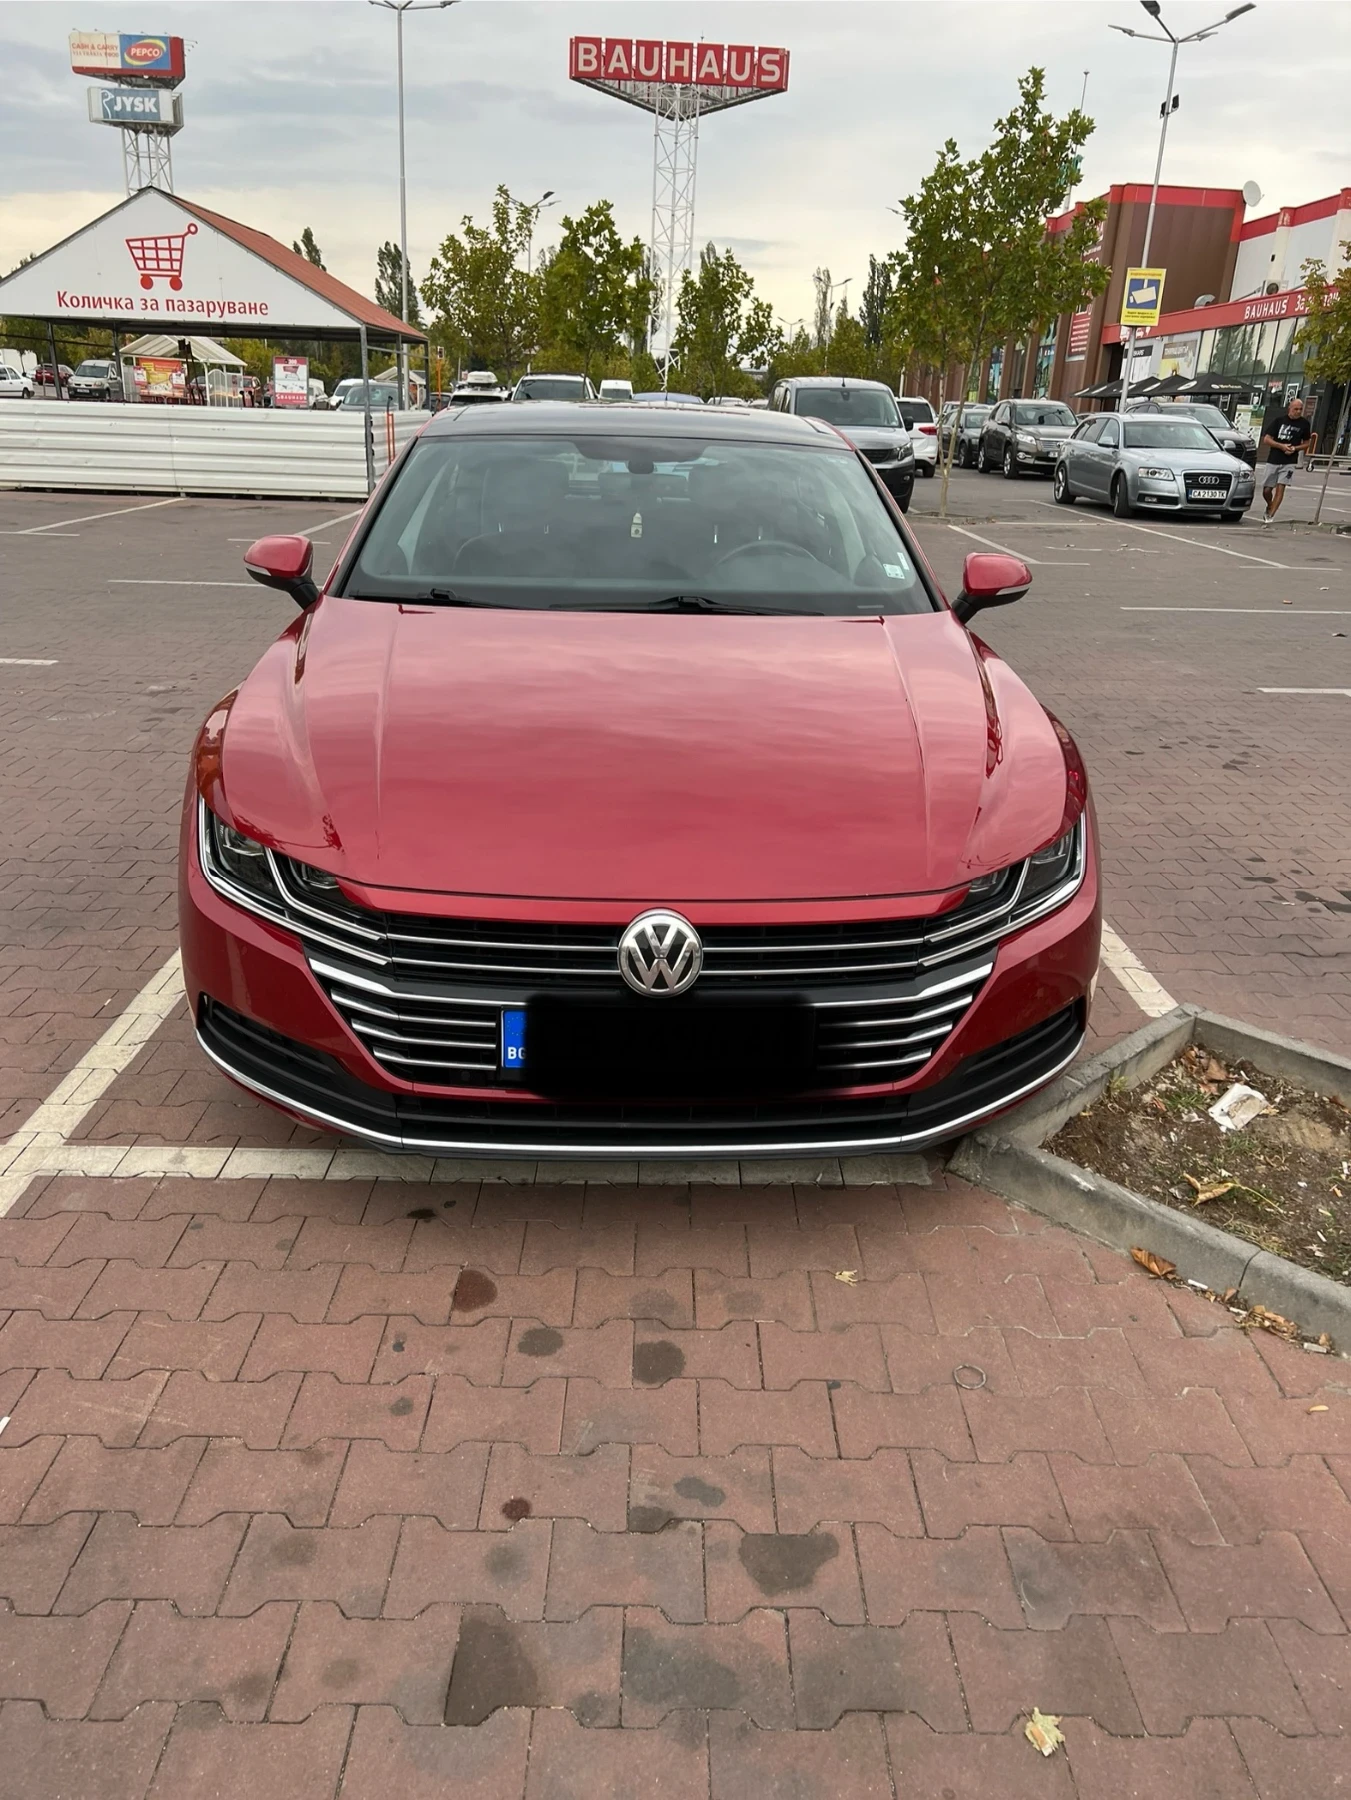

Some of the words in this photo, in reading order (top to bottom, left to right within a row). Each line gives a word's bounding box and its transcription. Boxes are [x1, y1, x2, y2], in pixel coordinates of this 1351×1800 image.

[71, 42, 90, 50] CASH
[131, 48, 160, 57] PEPCO
[577, 42, 782, 83] BAUHAUS
[114, 97, 158, 113] JYSK
[56, 290, 134, 311] Количка
[140, 297, 159, 311] за
[165, 298, 269, 318] пазаруване
[1243, 299, 1289, 320] BAUHAUS
